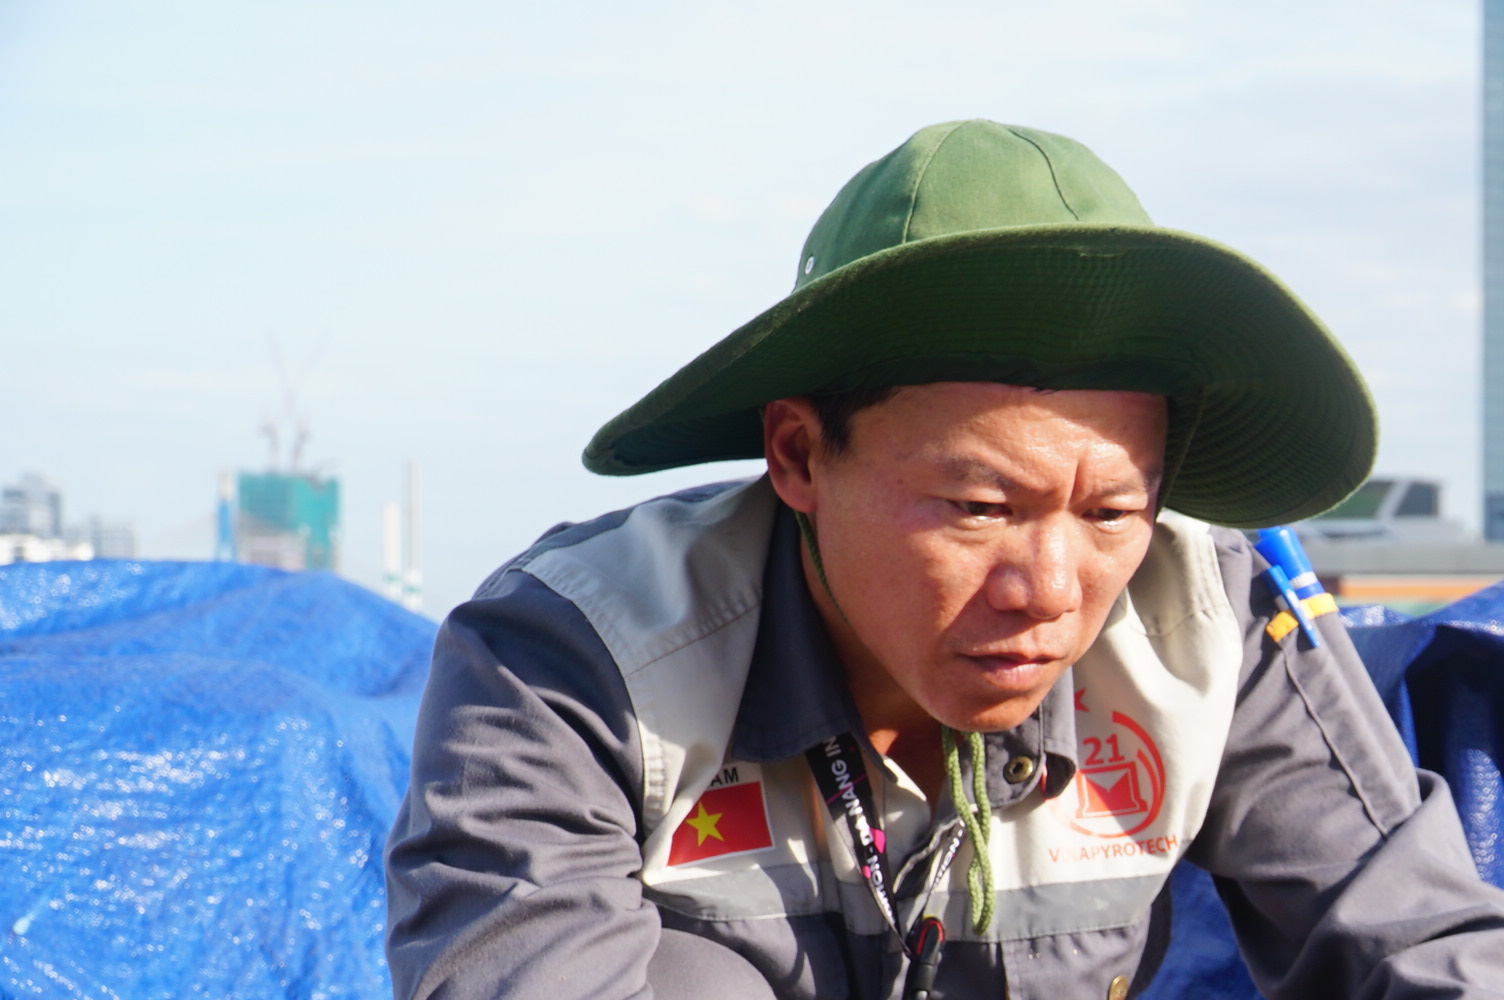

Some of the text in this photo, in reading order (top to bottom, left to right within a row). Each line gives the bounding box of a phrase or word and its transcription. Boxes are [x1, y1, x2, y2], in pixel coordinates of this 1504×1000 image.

[1082, 733, 1126, 766] 21
[831, 758, 863, 816] NANG
[1048, 833, 1178, 863] VAPYROTECH
